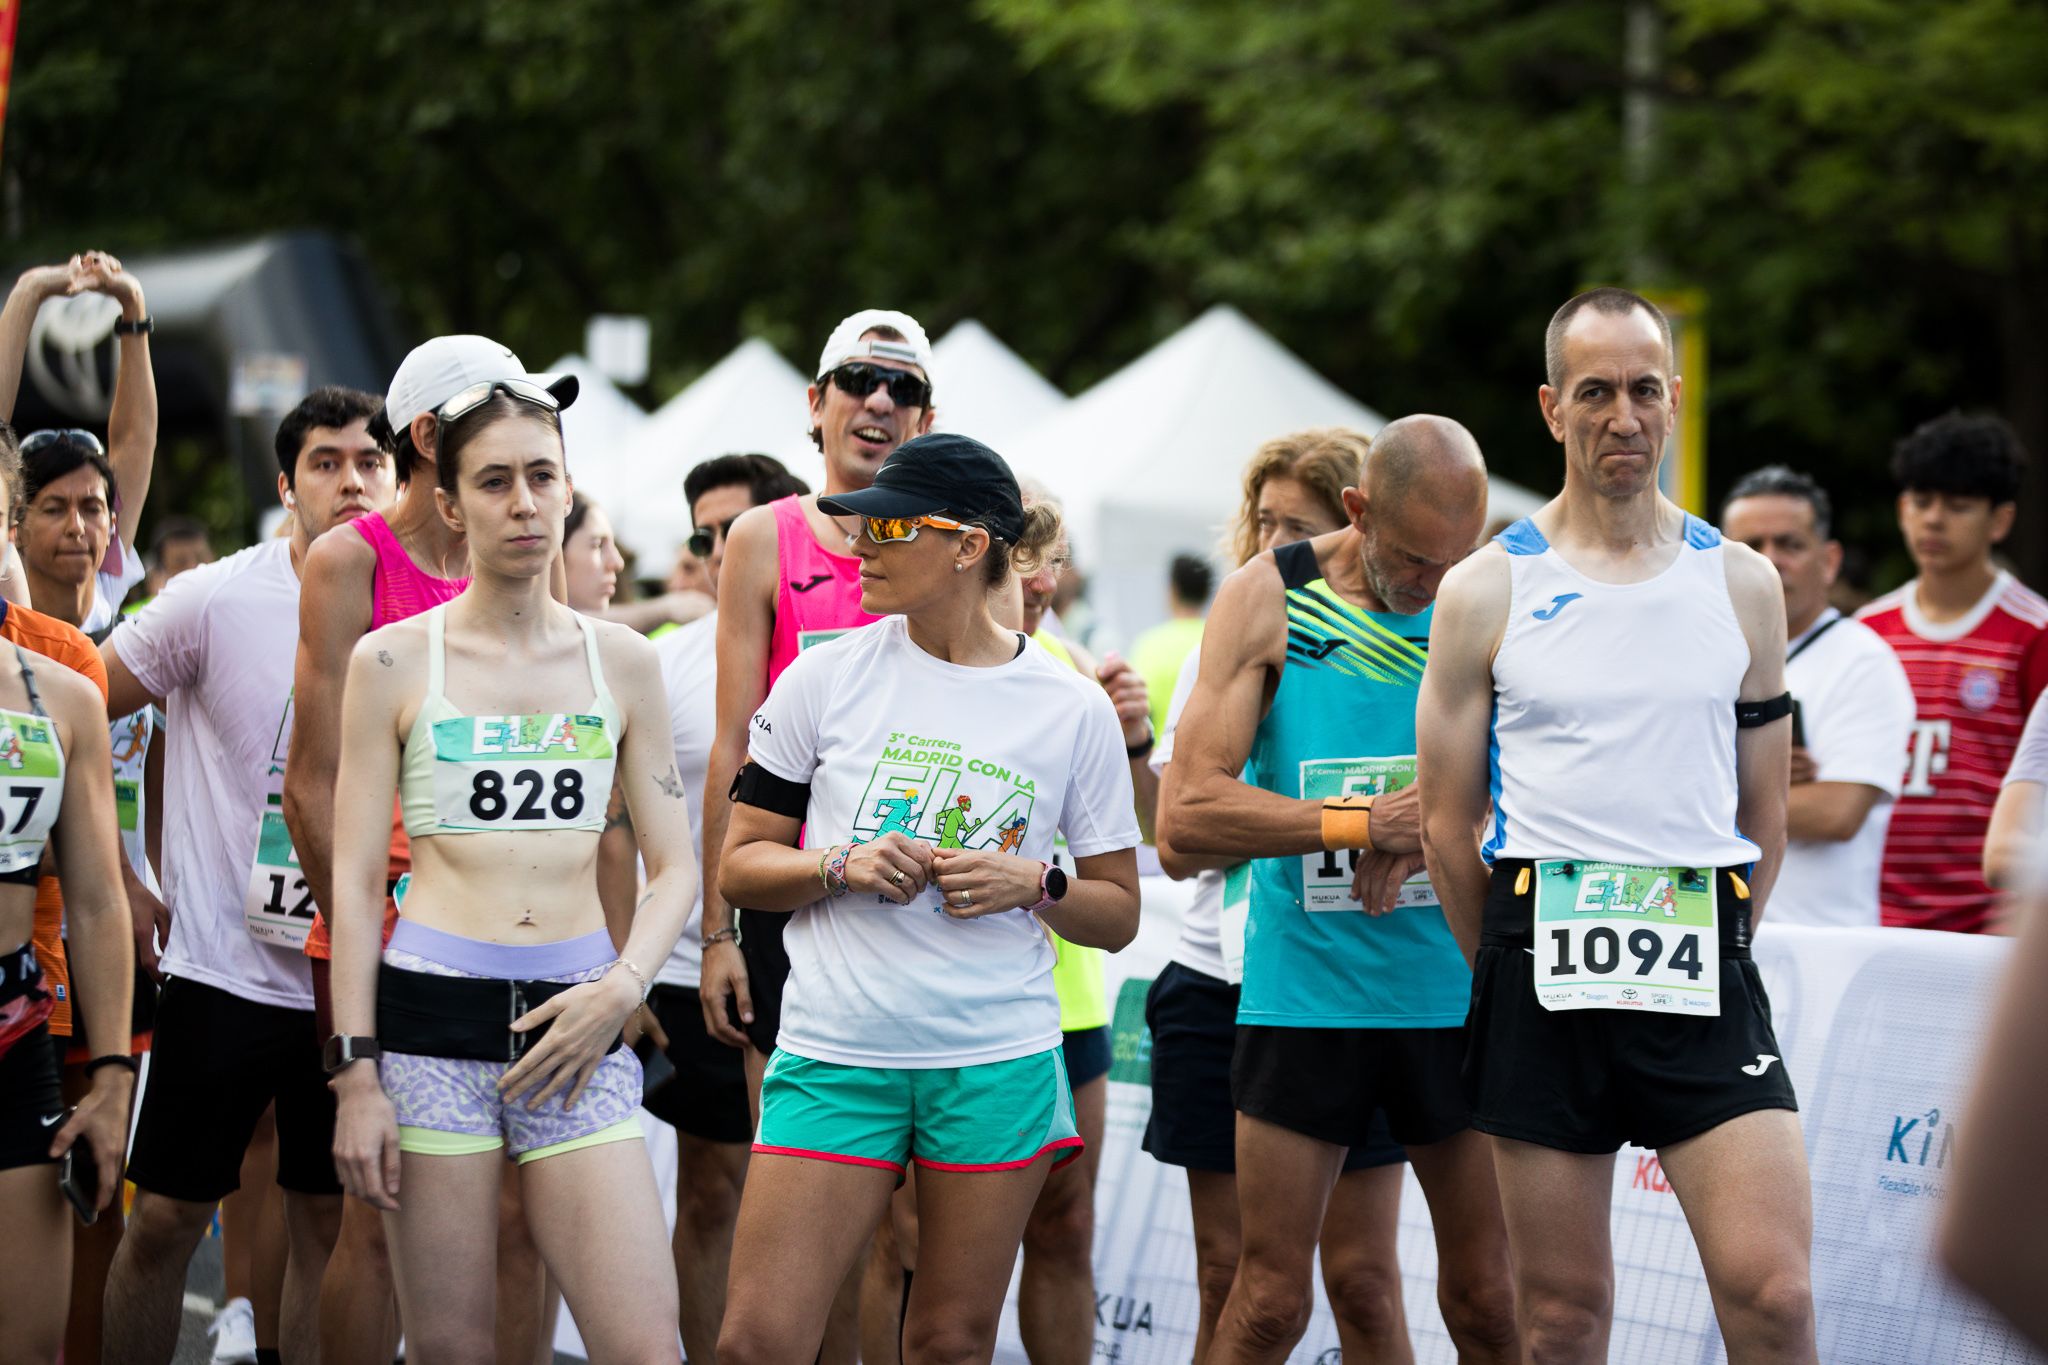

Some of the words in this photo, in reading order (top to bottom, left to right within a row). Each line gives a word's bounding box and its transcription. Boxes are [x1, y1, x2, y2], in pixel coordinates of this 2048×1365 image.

[472, 714, 579, 755] ELA
[907, 735, 962, 751] Carrera
[881, 746, 963, 767] MADRID
[967, 759, 1011, 782] CON
[1013, 774, 1036, 793] LA
[1344, 765, 1387, 774] MADRID
[1389, 765, 1411, 773] CON
[469, 768, 585, 821] 828
[853, 761, 1036, 856] ELA
[1583, 862, 1628, 875] MADRID
[1573, 871, 1677, 917] ELA
[1550, 926, 1703, 981] 1094
